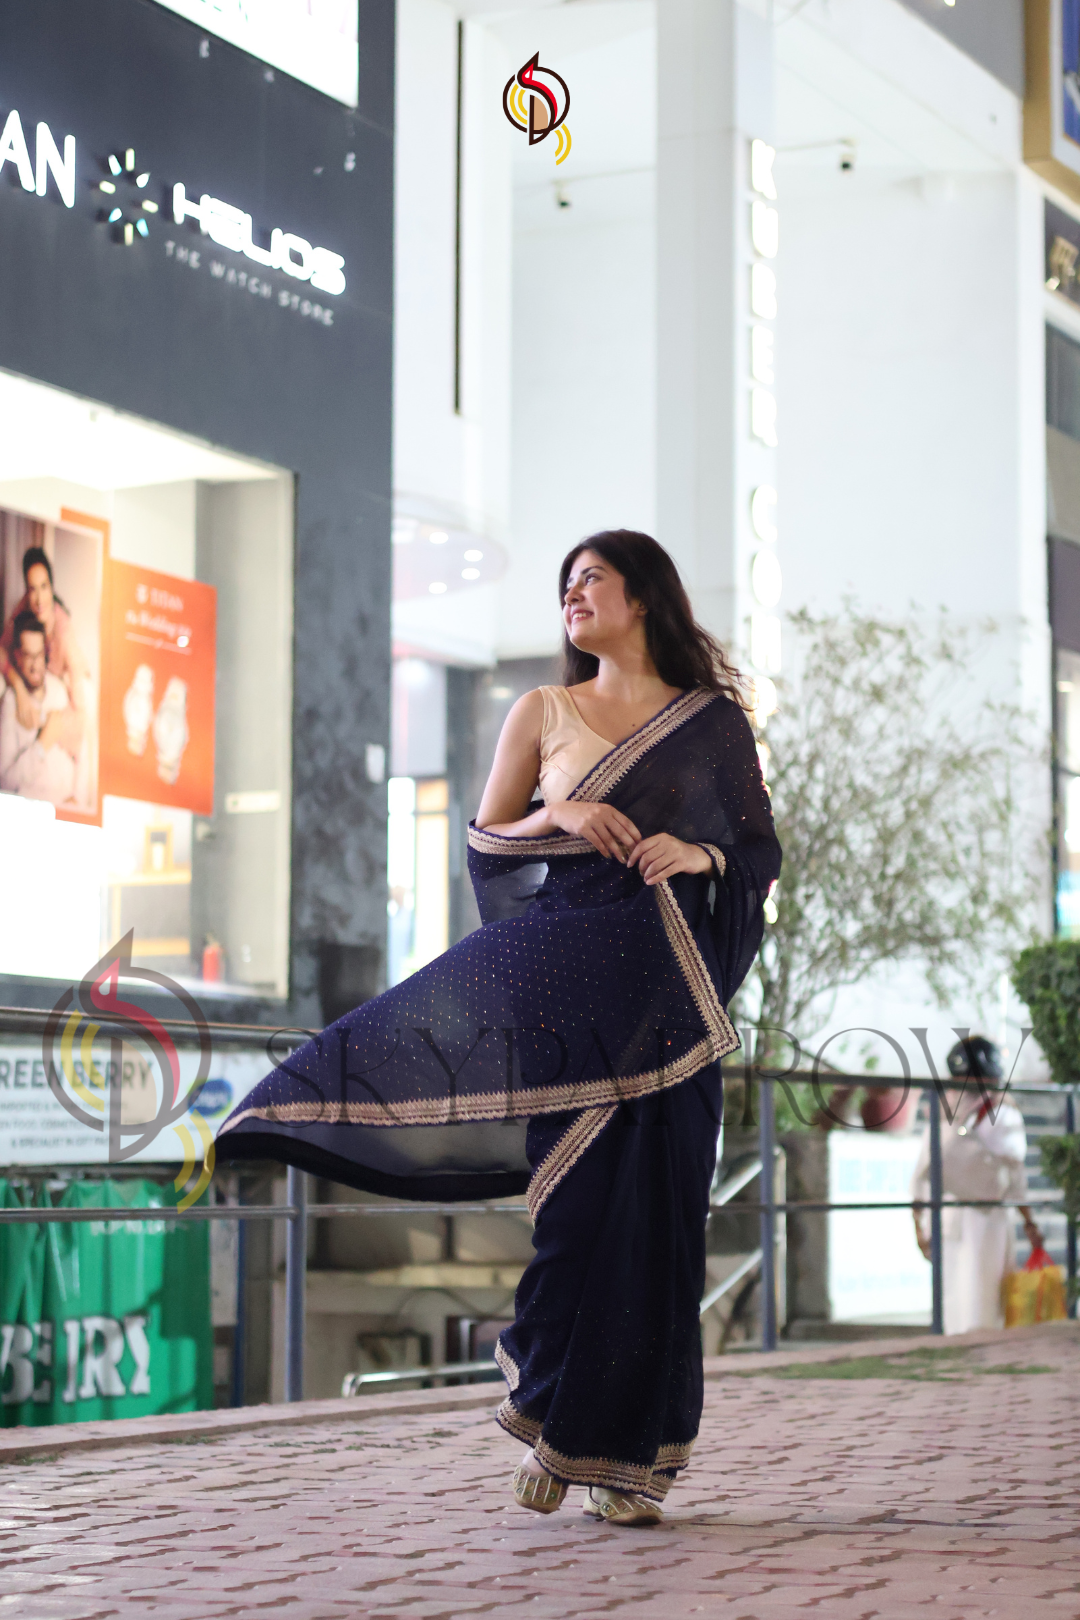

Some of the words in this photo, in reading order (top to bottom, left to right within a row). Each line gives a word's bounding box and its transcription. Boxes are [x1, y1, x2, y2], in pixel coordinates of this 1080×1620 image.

[165, 239, 201, 269] THE
[209, 259, 272, 299] WATCH
[278, 289, 335, 326] STORE
[172, 182, 346, 296] HELIOS
[71, 1059, 154, 1090] BERRY
